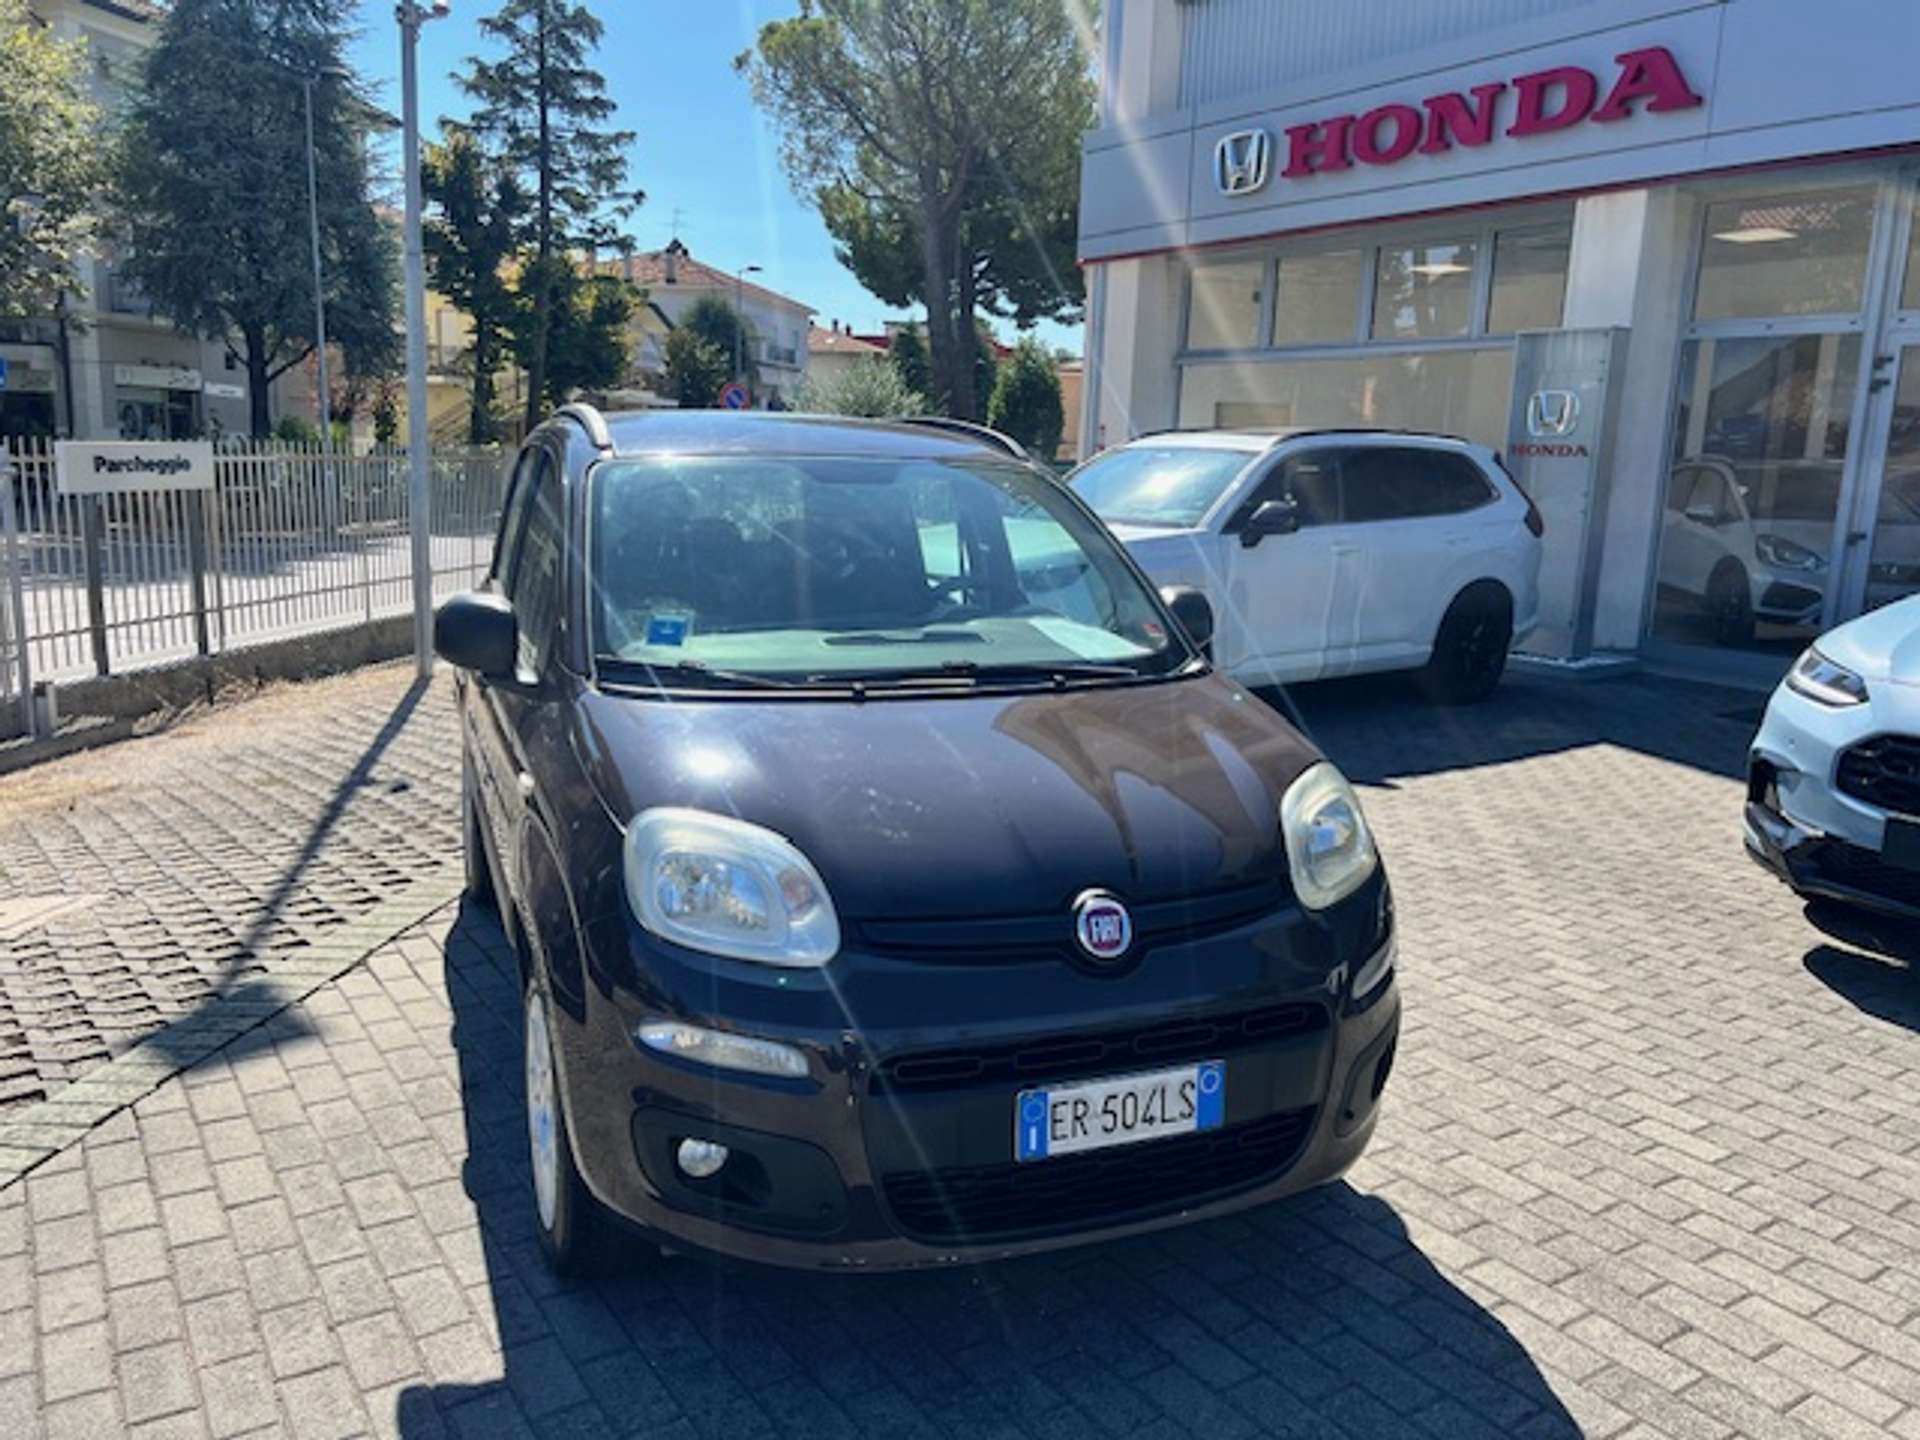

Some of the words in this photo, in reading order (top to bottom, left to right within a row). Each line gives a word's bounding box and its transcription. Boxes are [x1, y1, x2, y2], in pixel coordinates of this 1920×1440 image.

[1282, 46, 1703, 178] HONDA
[94, 455, 191, 475] Parcheggio
[1512, 444, 1588, 457] HONDA
[1051, 1099, 1089, 1141] ER
[1102, 1080, 1196, 1133] 504LS
